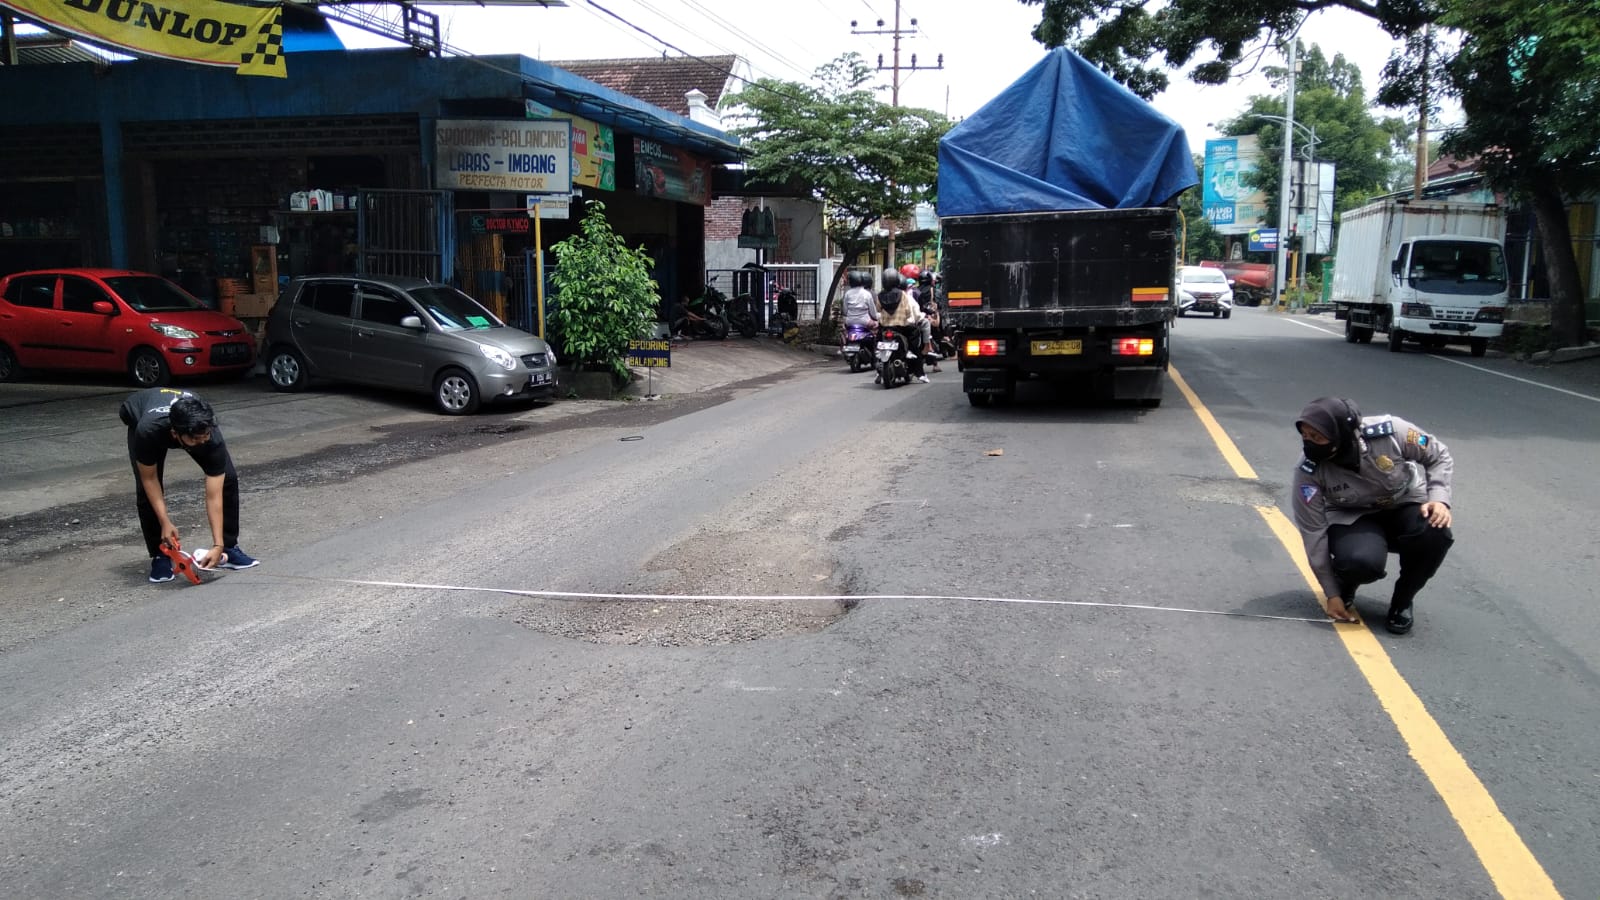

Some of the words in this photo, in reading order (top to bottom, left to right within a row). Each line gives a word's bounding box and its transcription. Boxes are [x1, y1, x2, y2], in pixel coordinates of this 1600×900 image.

[640, 140, 663, 158] ENEOS
[449, 152, 491, 172] LARAS
[508, 153, 556, 174] IMBANG
[459, 173, 507, 188] PERFECTA
[510, 176, 544, 189] MOTOR
[629, 340, 670, 350] SPOORING
[629, 356, 669, 367] BALANCING
